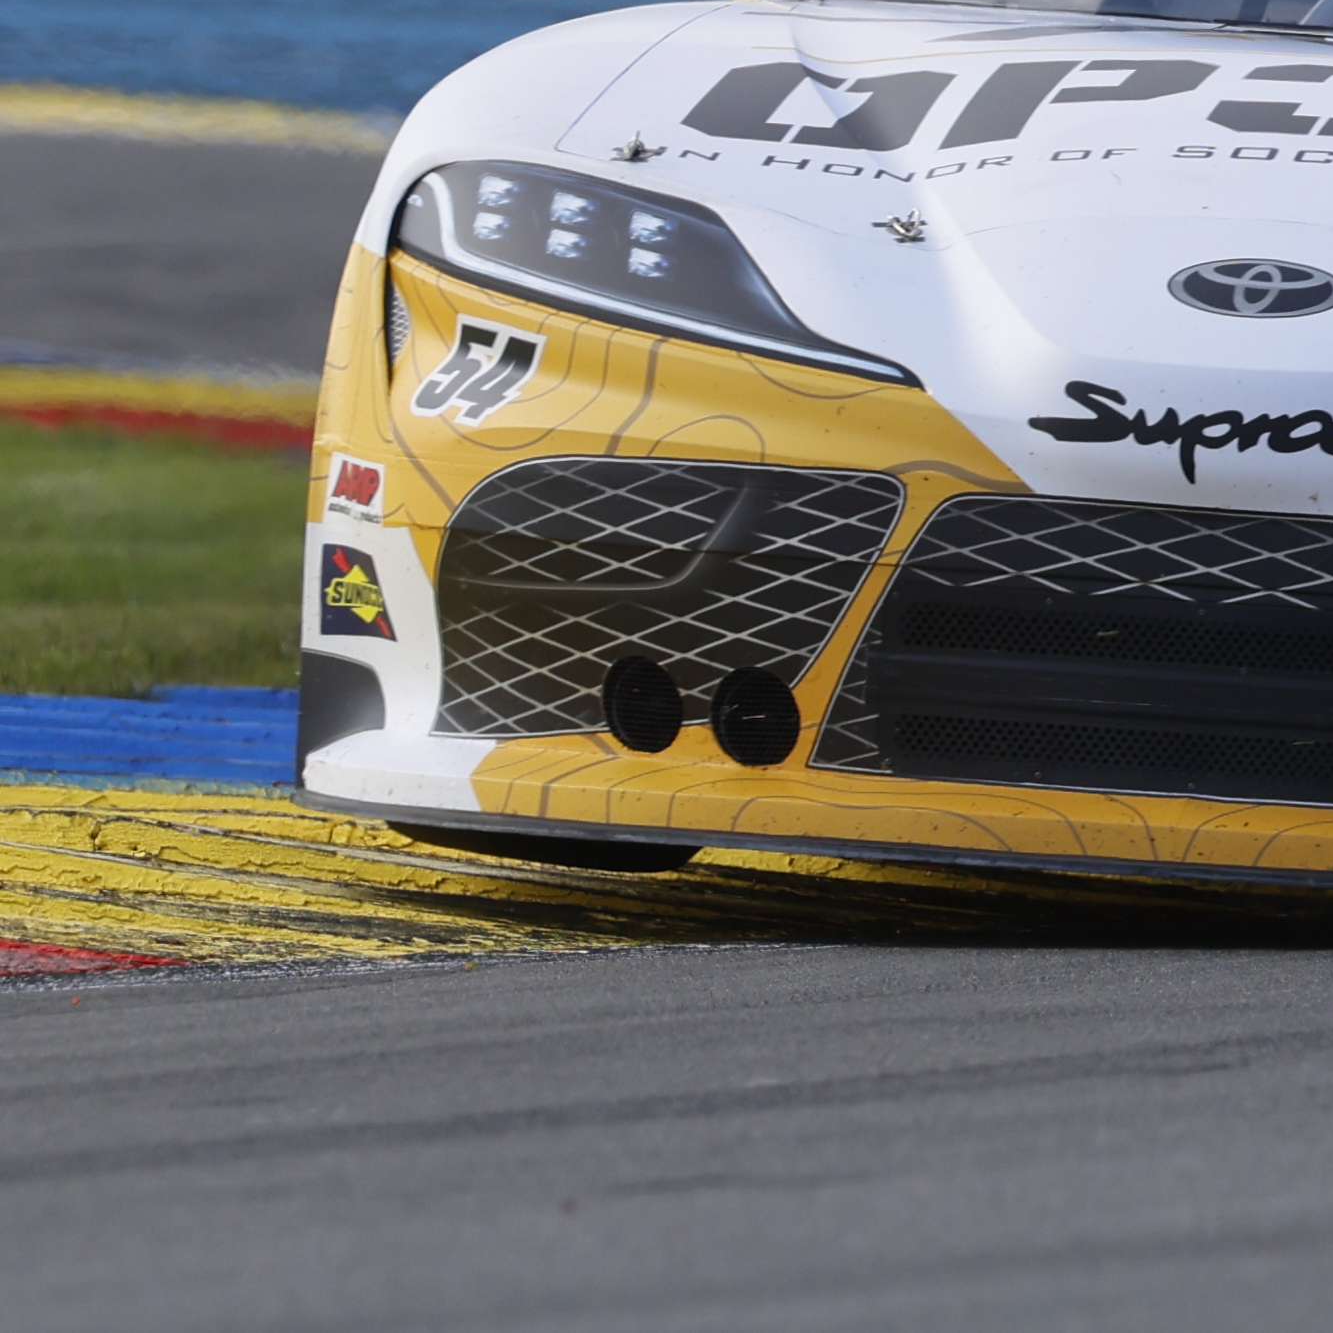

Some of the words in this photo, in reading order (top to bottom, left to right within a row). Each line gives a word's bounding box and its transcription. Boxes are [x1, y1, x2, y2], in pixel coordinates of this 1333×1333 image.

[761, 154, 1013, 183] HONOR
[1050, 146, 1138, 162] OF
[411, 317, 544, 425] 54
[331, 459, 382, 507] ARP
